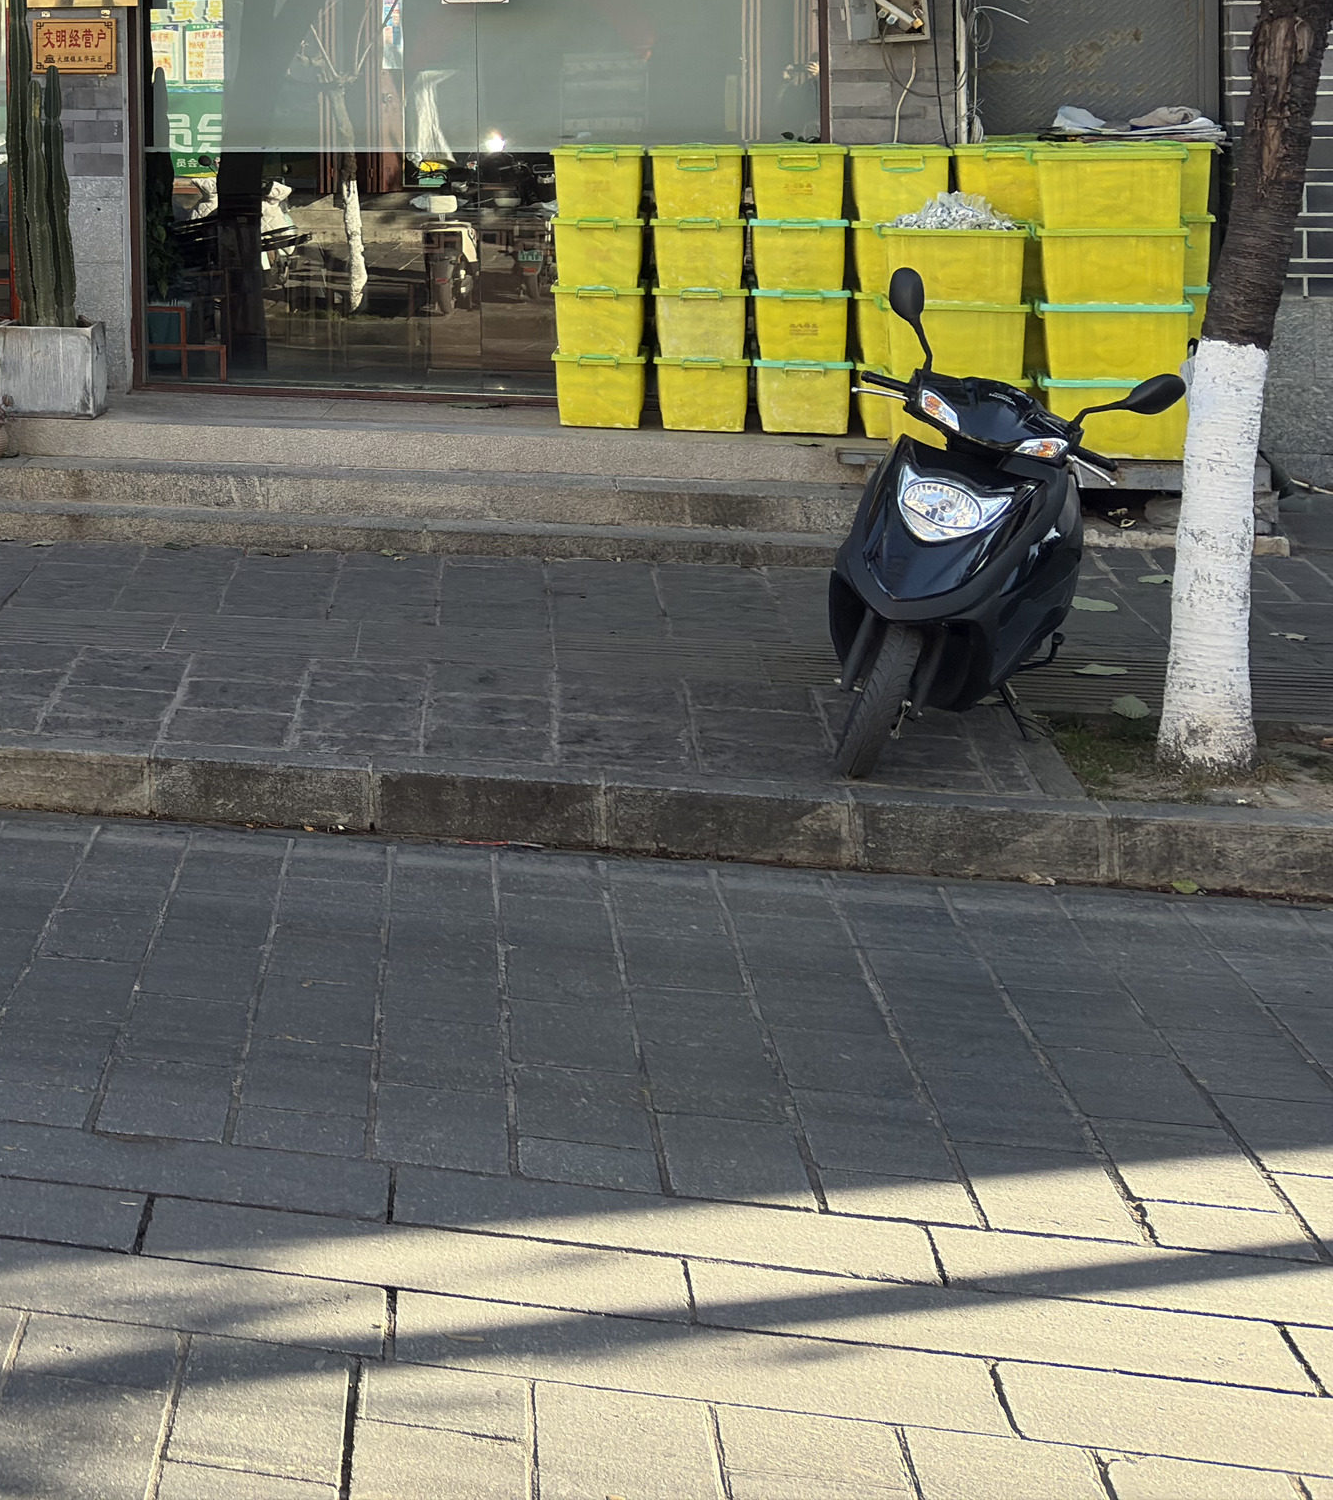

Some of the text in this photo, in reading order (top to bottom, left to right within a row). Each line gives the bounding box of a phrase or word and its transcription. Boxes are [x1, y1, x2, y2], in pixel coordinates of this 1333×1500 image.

[42, 28, 107, 49] 文明经营户
